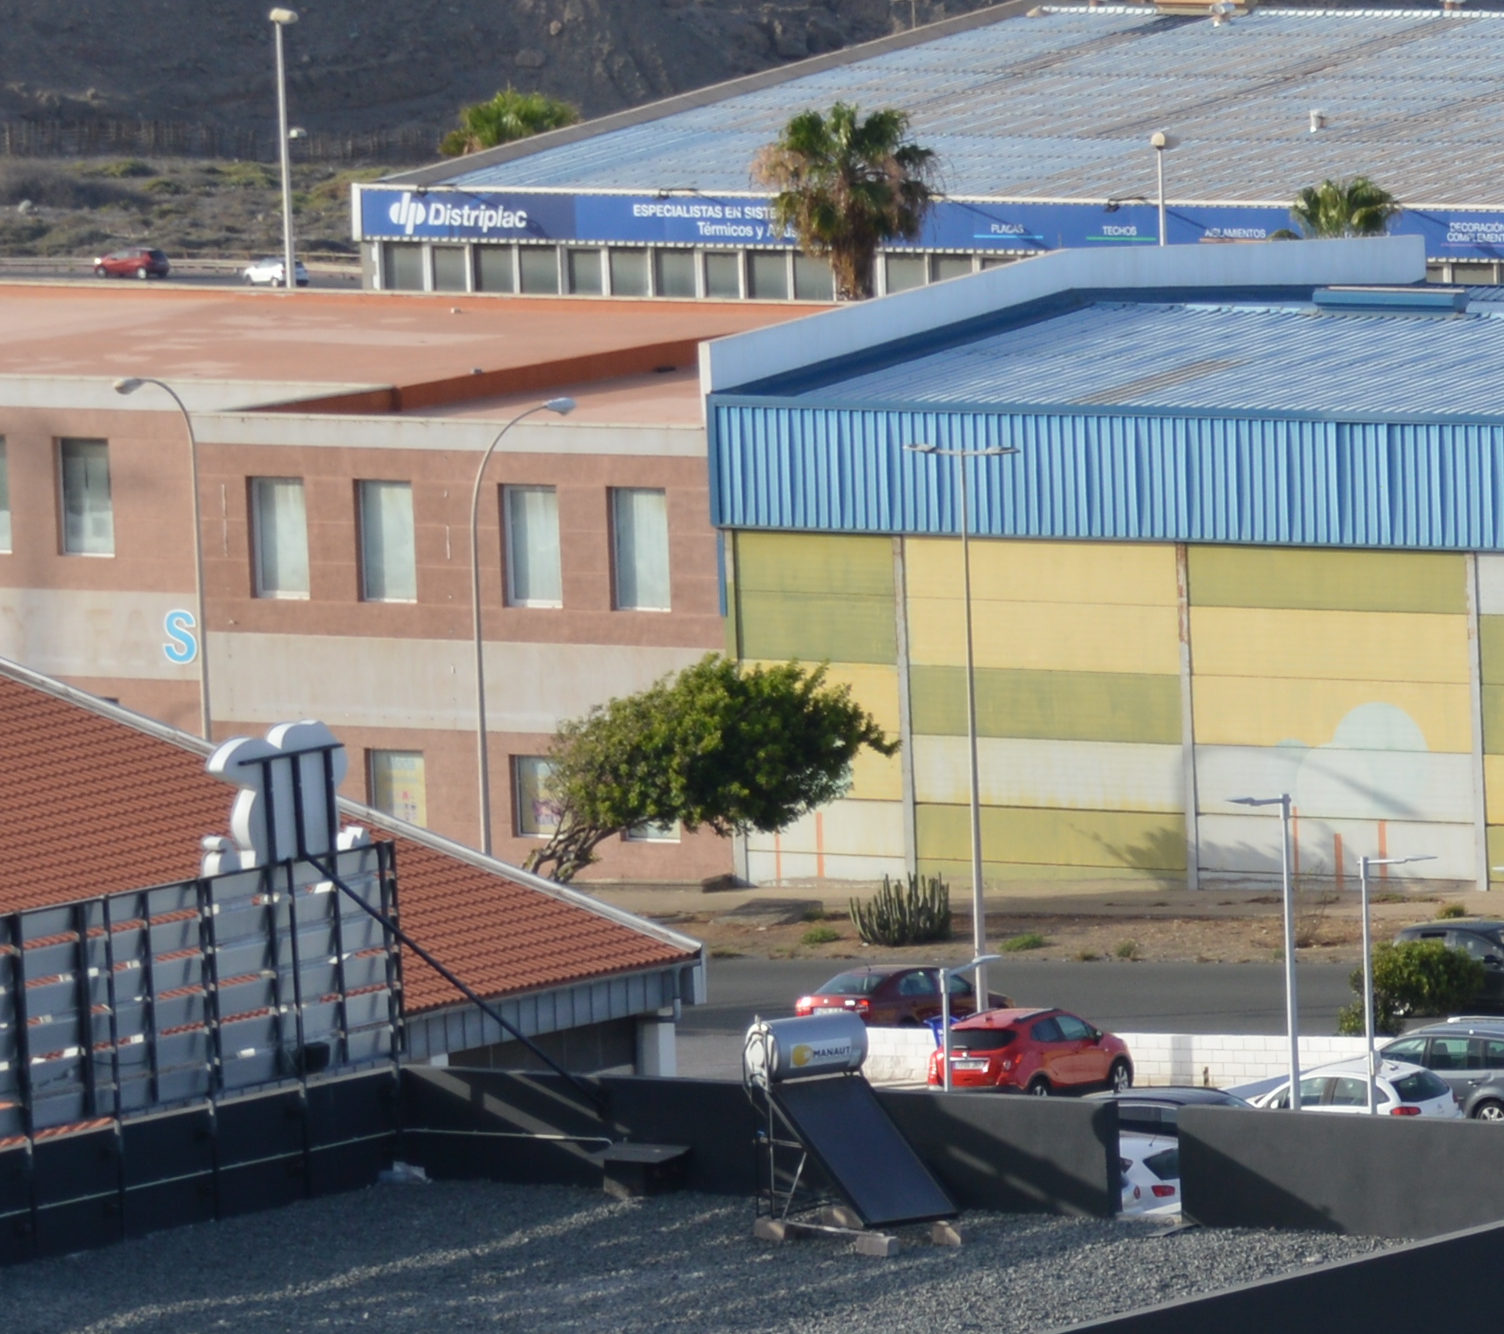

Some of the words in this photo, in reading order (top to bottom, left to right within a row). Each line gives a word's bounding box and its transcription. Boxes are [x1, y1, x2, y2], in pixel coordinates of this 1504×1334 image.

[428, 202, 528, 234] Distriplac
[632, 203, 723, 219] ESPECIALISTAS
[724, 206, 742, 219] EN
[696, 221, 753, 238] Térmicos
[755, 224, 764, 241] y
[991, 223, 1024, 234] PLACAS
[1102, 225, 1137, 236] TECHOS
[811, 1045, 852, 1059] MANAUT
